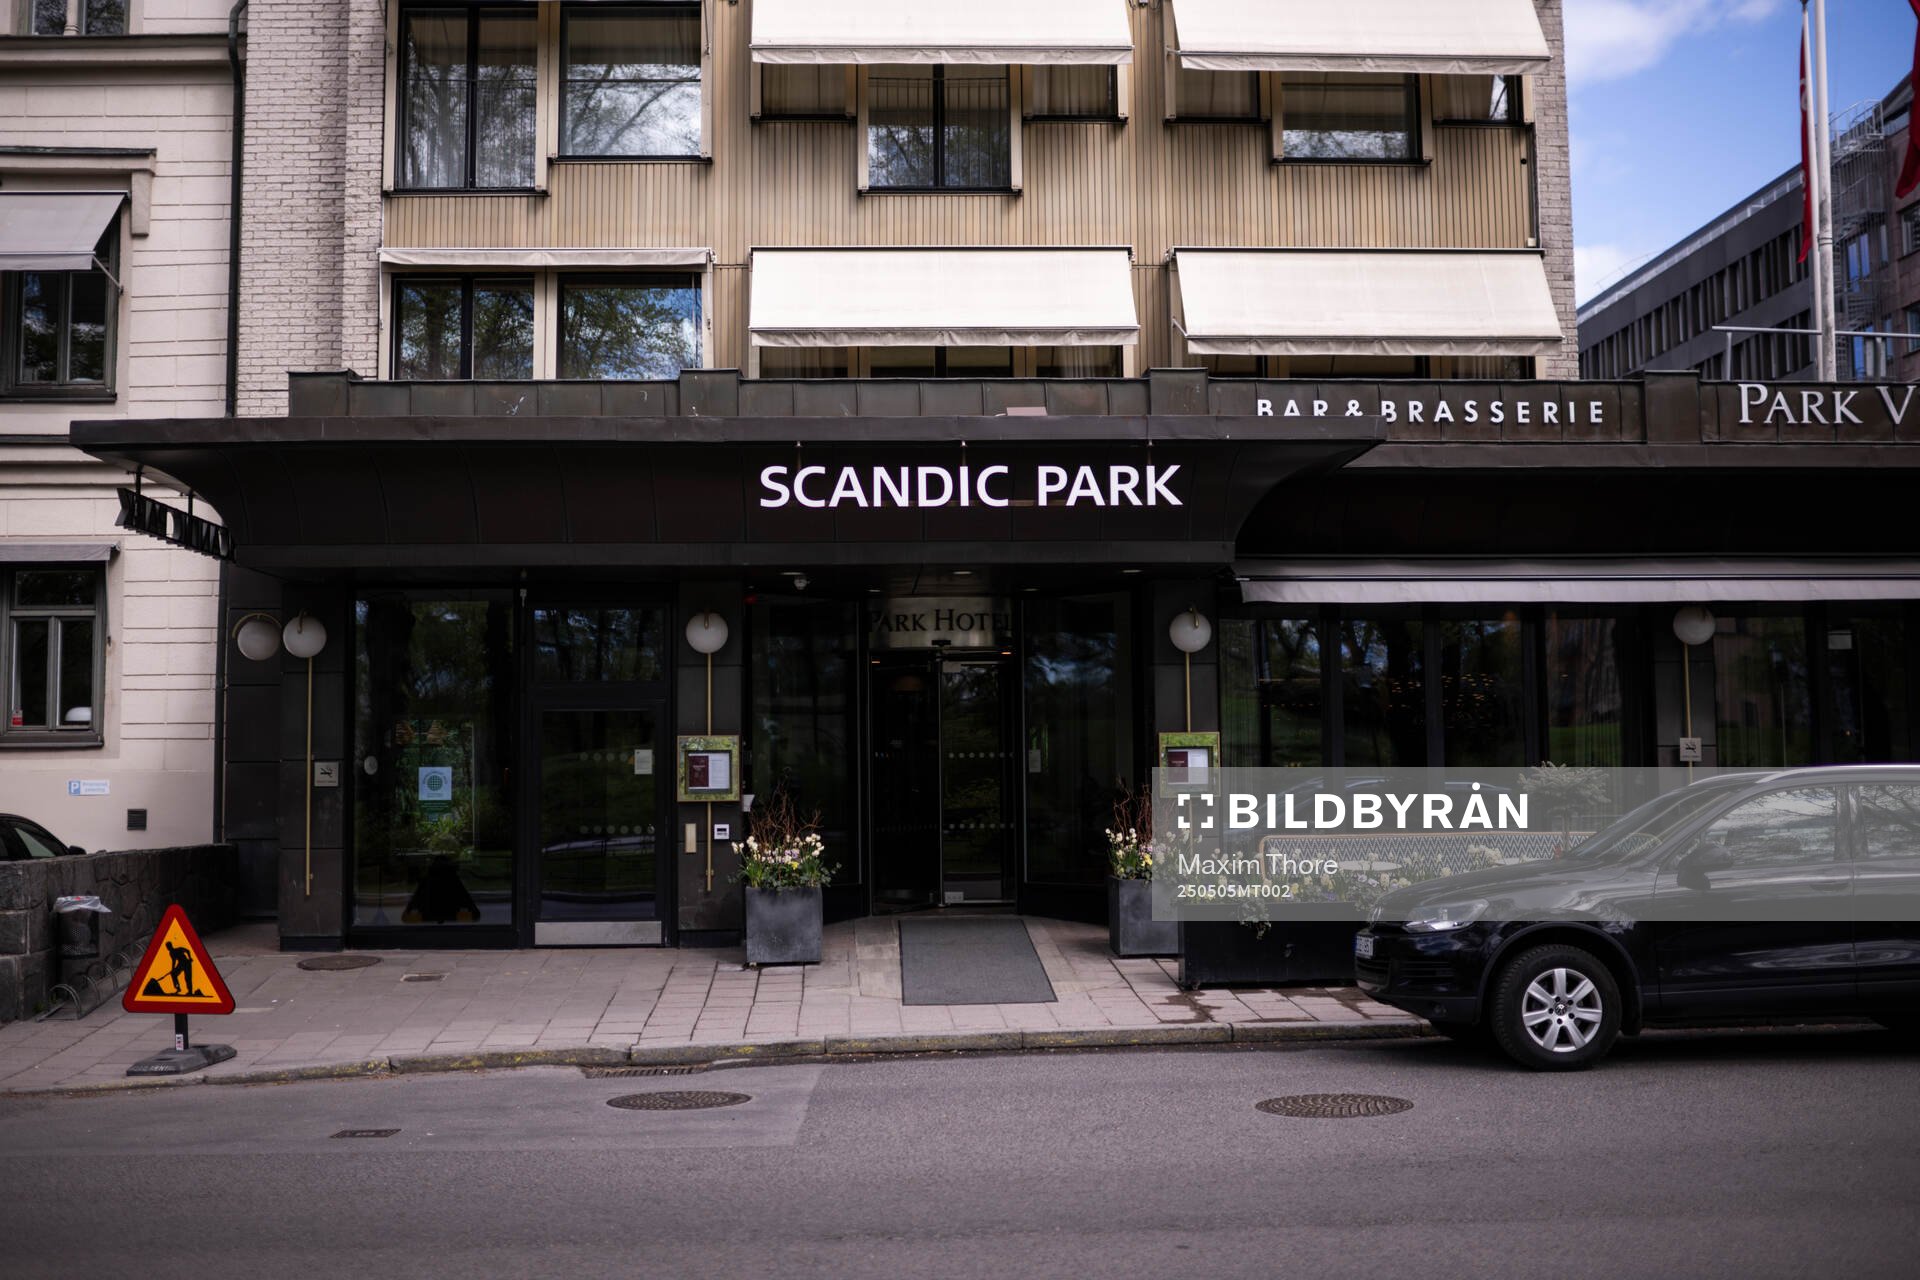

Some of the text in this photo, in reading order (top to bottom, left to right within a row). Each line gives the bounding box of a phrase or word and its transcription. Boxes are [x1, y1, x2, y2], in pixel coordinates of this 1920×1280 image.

[1257, 398, 1603, 424] BAR & BRASSERIE
[1738, 383, 1864, 424] PARK
[759, 464, 1184, 507] SCANDIC PARK
[934, 608, 1013, 632] HOTEL
[71, 782, 80, 794] P
